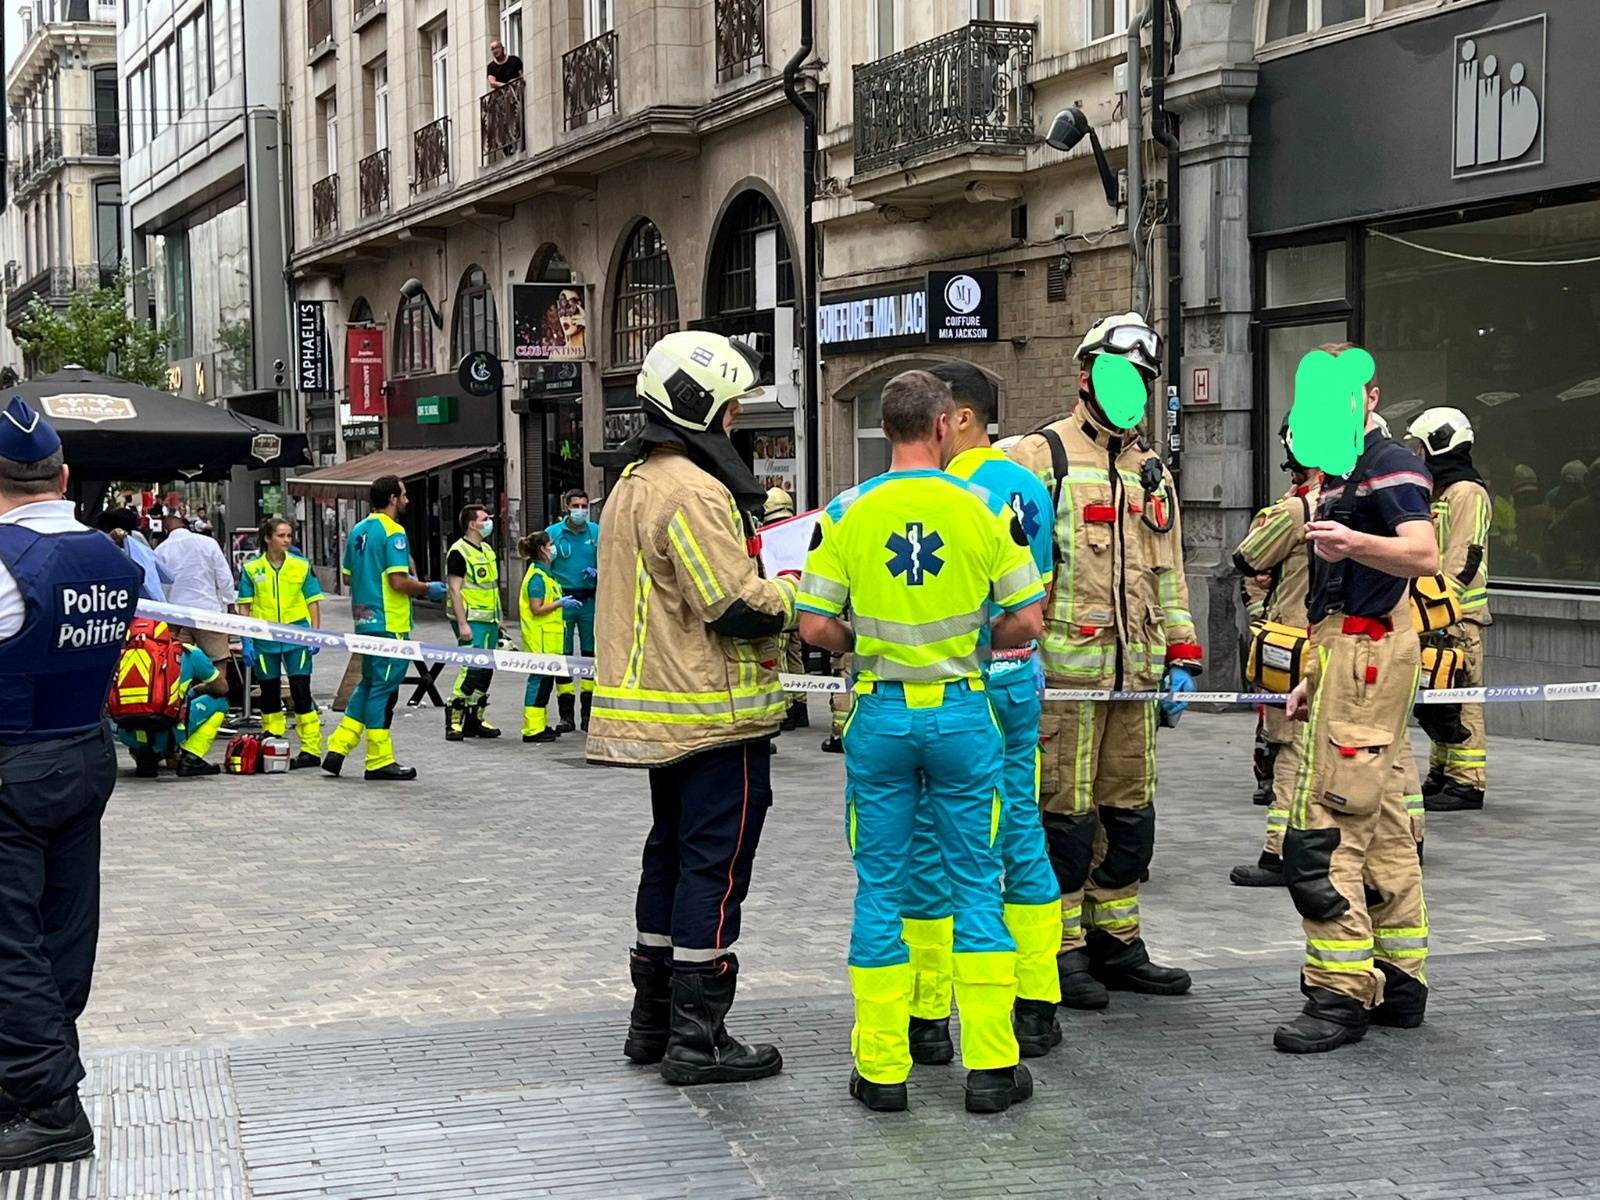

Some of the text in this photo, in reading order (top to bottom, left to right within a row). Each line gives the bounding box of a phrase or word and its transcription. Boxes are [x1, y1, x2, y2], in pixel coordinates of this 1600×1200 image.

[817, 298, 871, 344] COIFFURE
[872, 295, 896, 338] MIA
[945, 316, 981, 327] COIFFURE
[301, 304, 316, 388] RAPHAELI'S
[938, 328, 988, 339] MIA JACKSON
[719, 361, 738, 383] 11
[1197, 374, 1206, 396] H
[63, 584, 128, 615] Police
[57, 616, 126, 648] Politie
